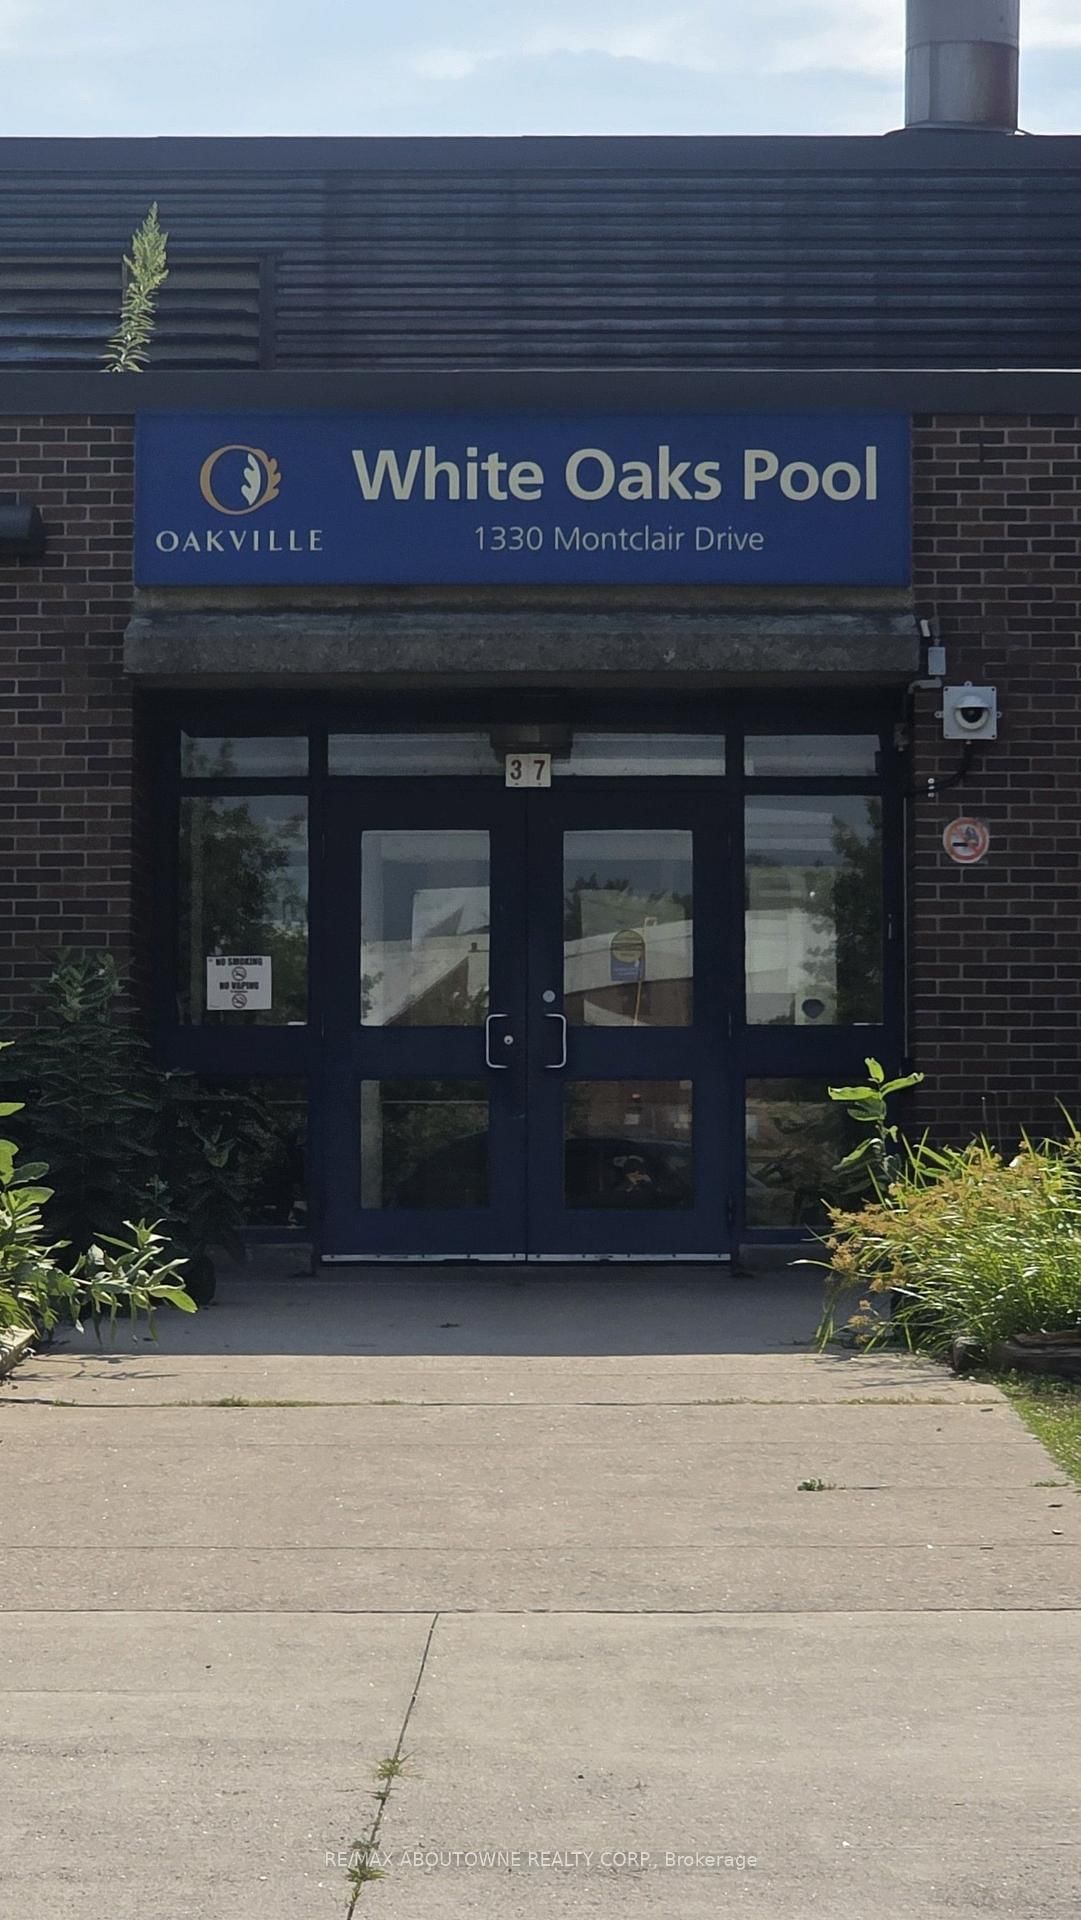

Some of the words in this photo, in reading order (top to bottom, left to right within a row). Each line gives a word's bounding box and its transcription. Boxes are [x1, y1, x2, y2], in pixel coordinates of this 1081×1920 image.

[352, 445, 544, 502] White
[565, 445, 722, 502] Oaks
[745, 445, 878, 502] Pool
[155, 528, 324, 553] OAKVILLE
[475, 526, 543, 552] 1330
[553, 525, 685, 552] Montclair
[694, 526, 764, 552] Drive
